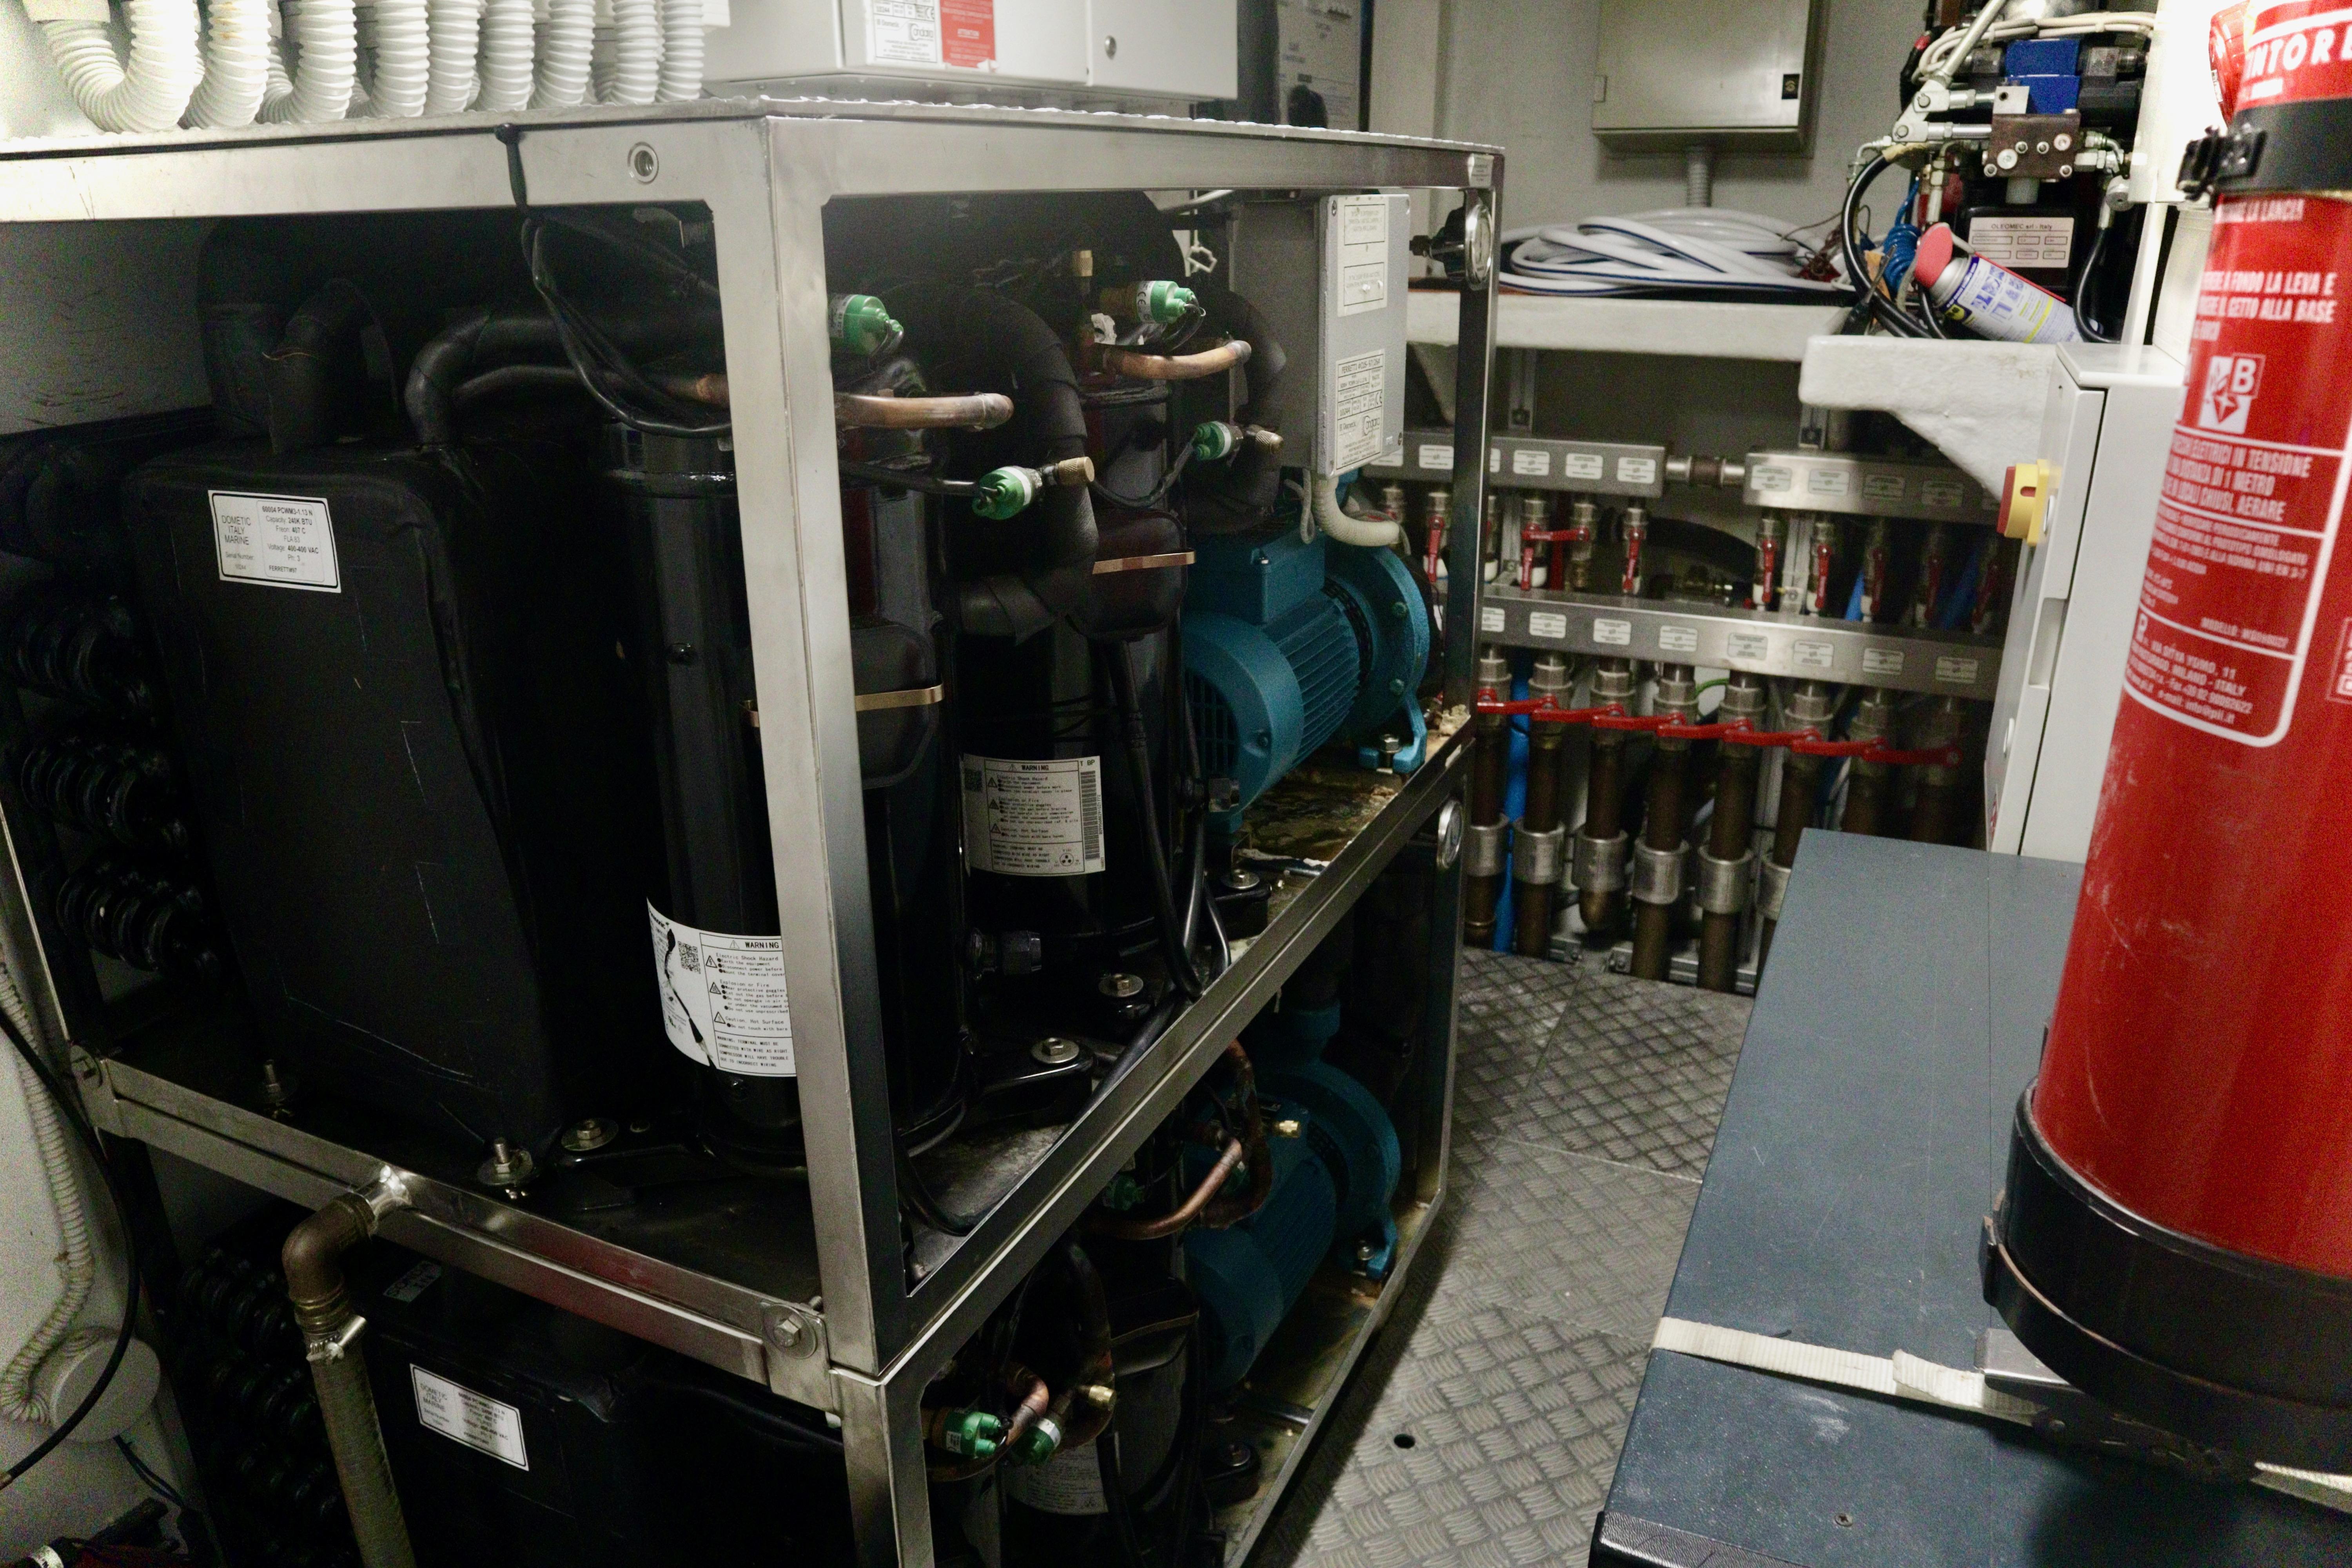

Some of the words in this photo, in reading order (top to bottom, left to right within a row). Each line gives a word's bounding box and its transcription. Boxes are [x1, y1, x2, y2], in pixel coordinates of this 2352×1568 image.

[2264, 271, 2283, 294] LA
[2283, 271, 2321, 295] LEVA
[2323, 272, 2337, 296] E
[2258, 298, 2293, 321] ALLA
[2293, 299, 2338, 323] BASE
[2232, 358, 2257, 393] B
[2247, 448, 2313, 478] TENSIONE
[2232, 470, 2276, 497] METRO
[221, 515, 251, 526] DOMETIC
[2236, 495, 2287, 522] AERARE
[225, 535, 249, 545] MARINE
[229, 526, 245, 535] ITALY
[2172, 664, 2207, 686] MILANO
[2214, 679, 2247, 697] ITALY
[2222, 667, 2237, 680] 11
